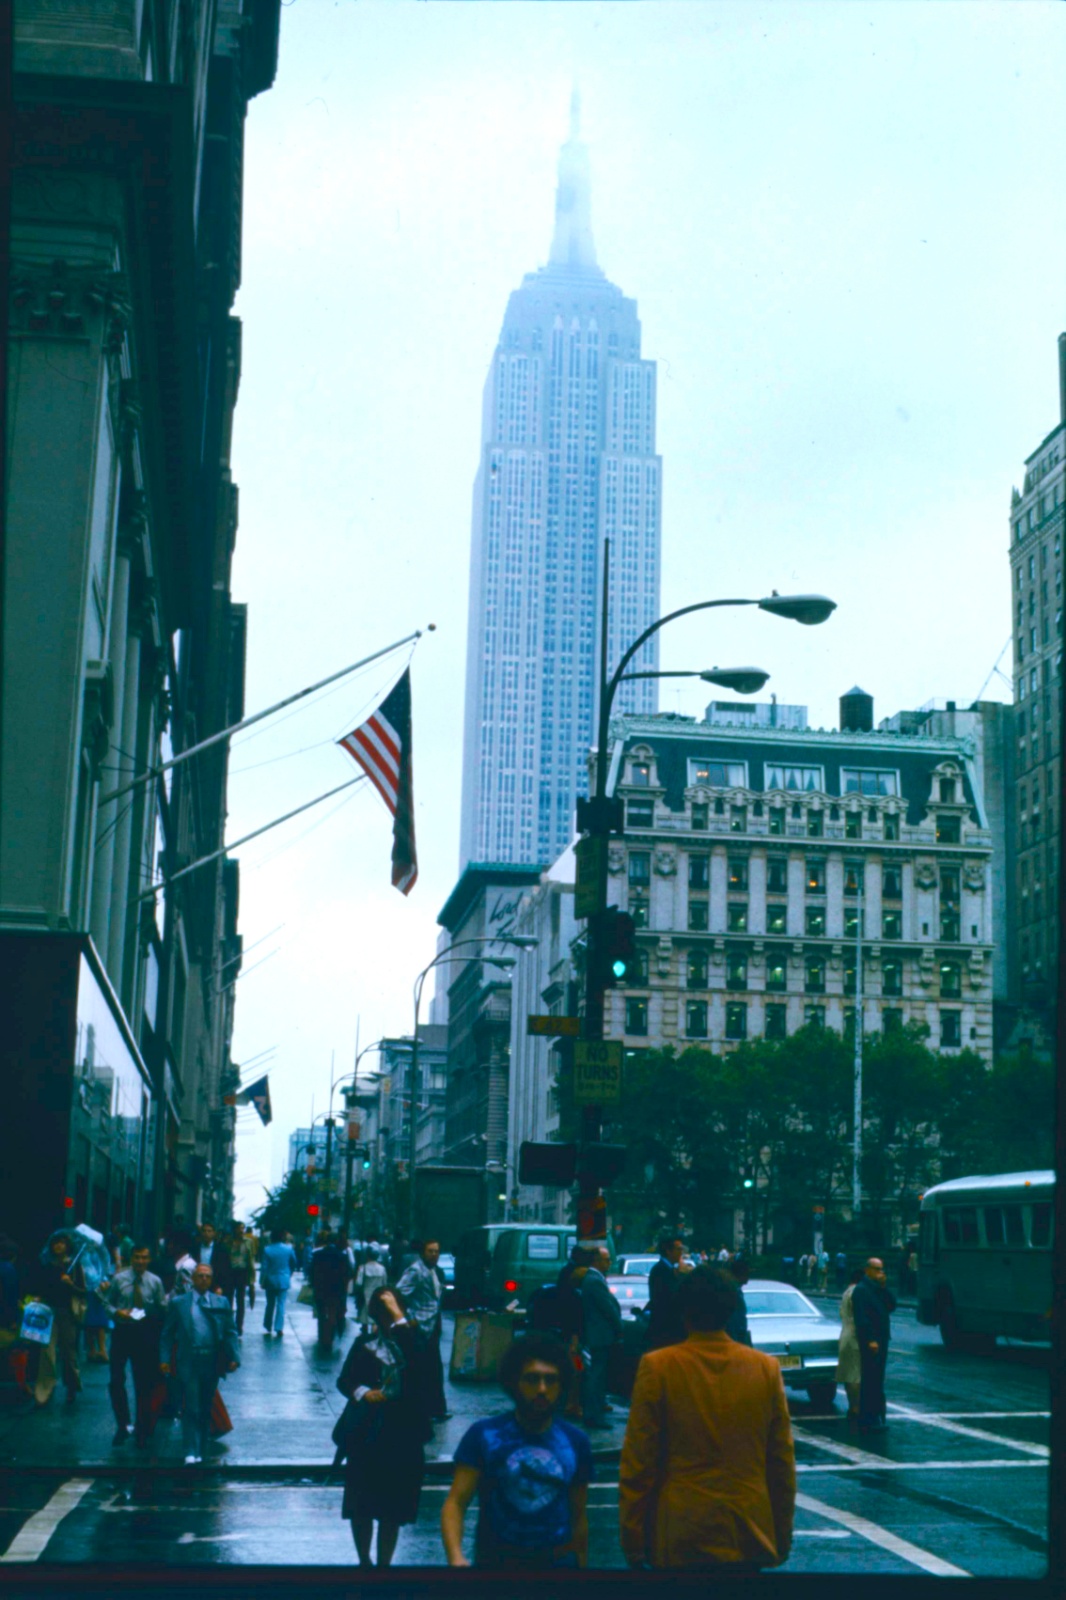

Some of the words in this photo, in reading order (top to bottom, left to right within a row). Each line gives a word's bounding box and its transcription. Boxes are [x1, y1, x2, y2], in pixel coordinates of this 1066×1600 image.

[489, 891, 523, 924] Lord
[586, 1046, 608, 1062] NO
[575, 1064, 618, 1081] TURNS
